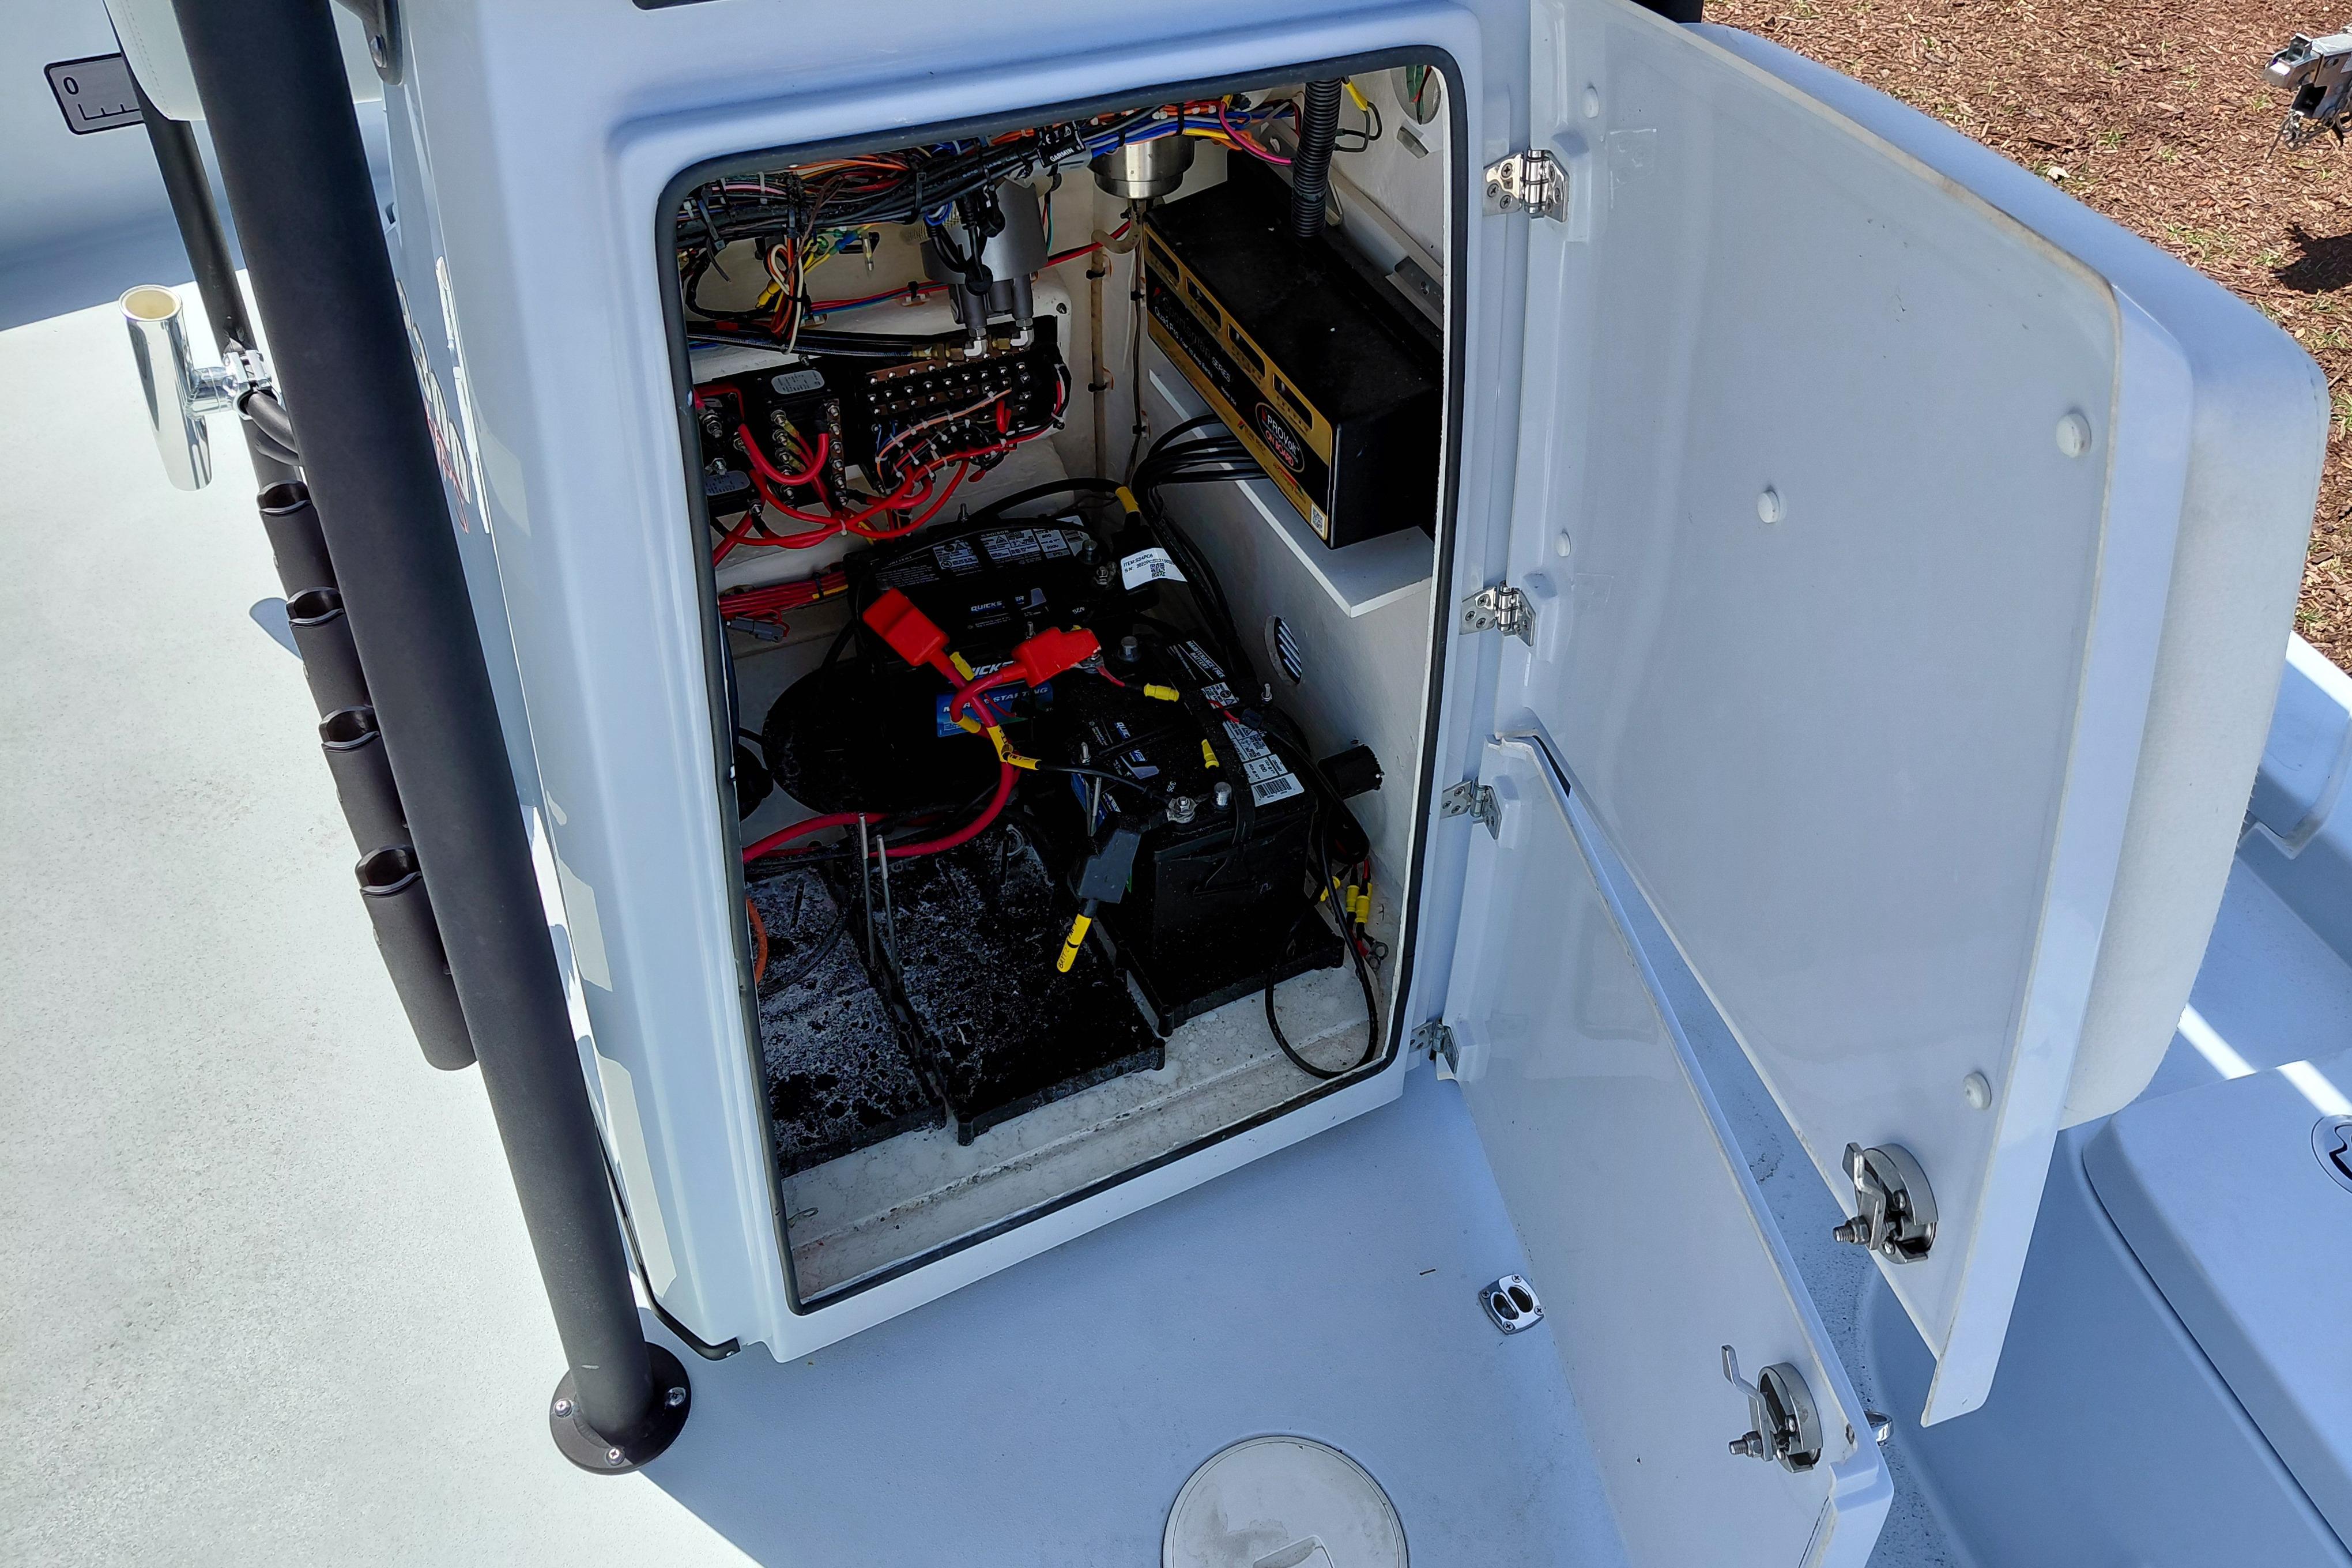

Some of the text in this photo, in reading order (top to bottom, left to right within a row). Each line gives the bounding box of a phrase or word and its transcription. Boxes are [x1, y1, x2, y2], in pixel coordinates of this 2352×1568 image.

[63, 77, 79, 95] 0
[1050, 148, 1075, 162] GARMIN
[1170, 323, 1178, 339] Pro
[1212, 356, 1230, 382] SERIES
[1275, 440, 1294, 466] BOARD
